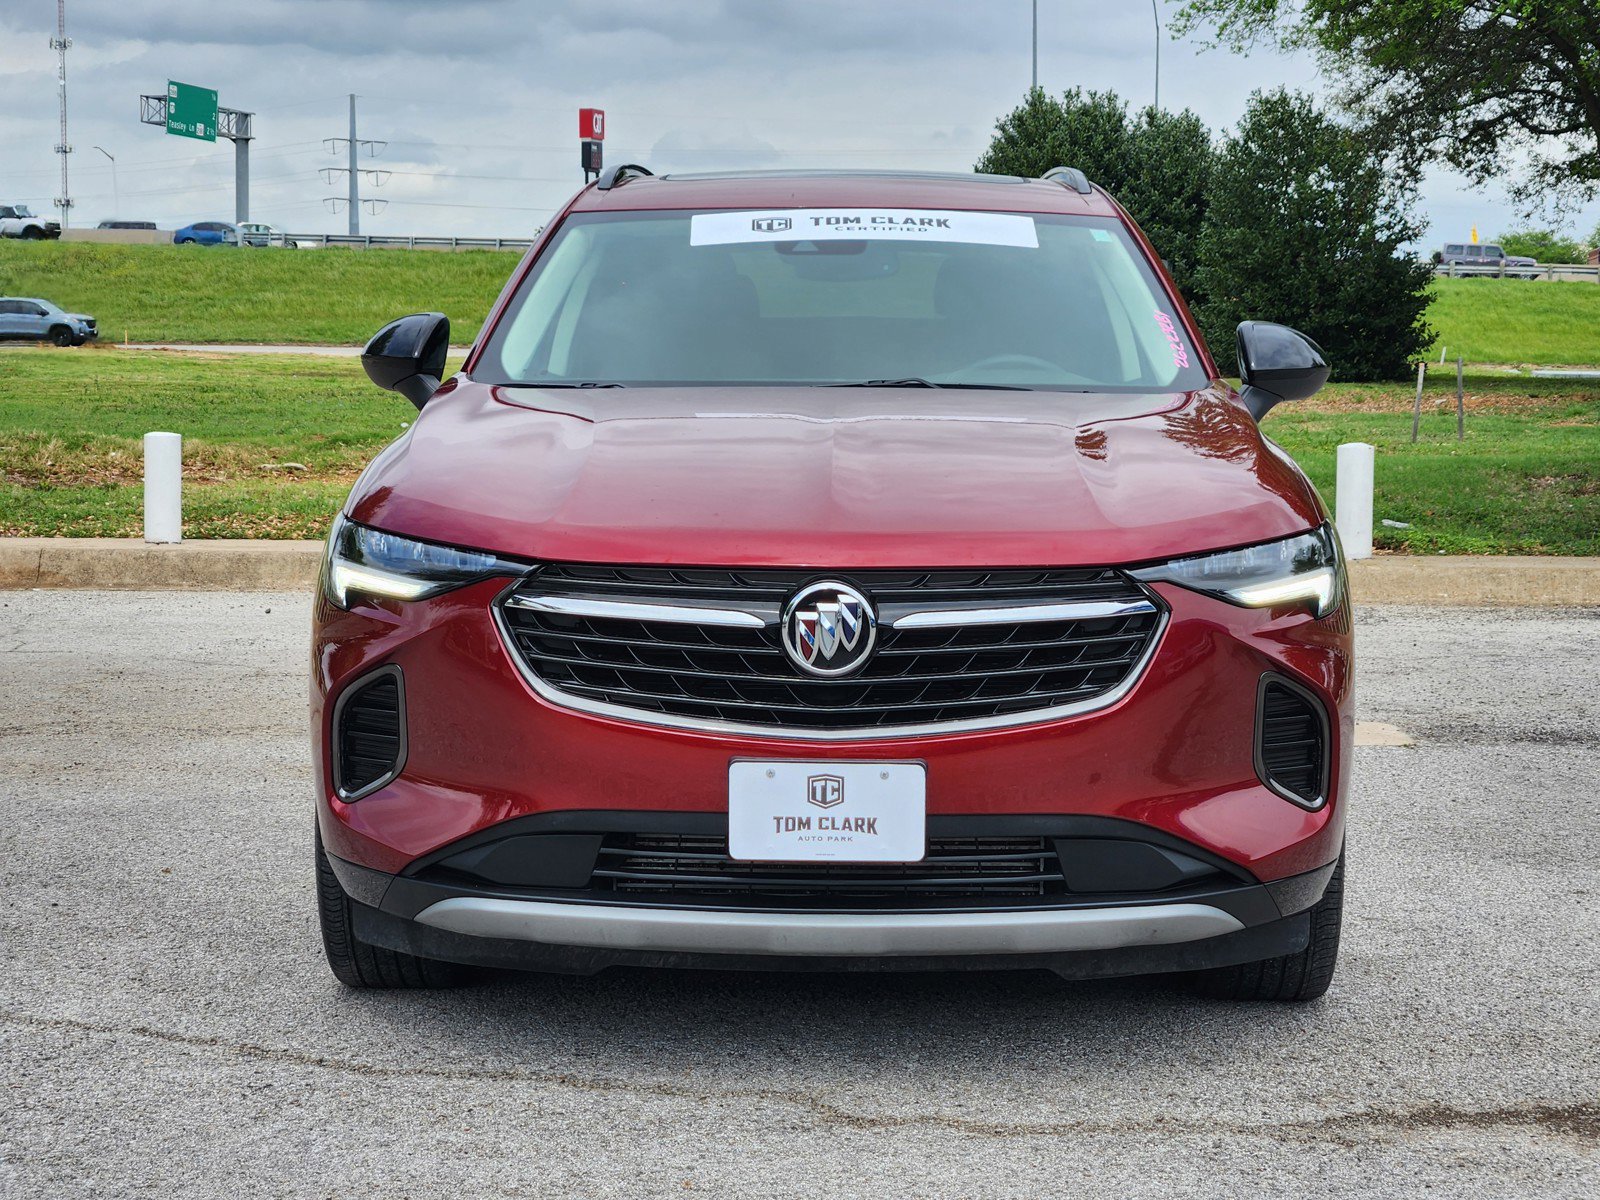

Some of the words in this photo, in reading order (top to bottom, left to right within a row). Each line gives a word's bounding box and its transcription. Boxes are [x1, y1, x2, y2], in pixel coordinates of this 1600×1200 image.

[211, 112, 216, 121] 2
[593, 112, 603, 134] QT
[168, 119, 187, 133] Teasley
[188, 123, 195, 132] Ln
[810, 216, 861, 227] TOM
[871, 216, 951, 229] CLARK
[812, 780, 840, 803] TC
[772, 815, 812, 834] TOM
[817, 816, 878, 836] CLARK
